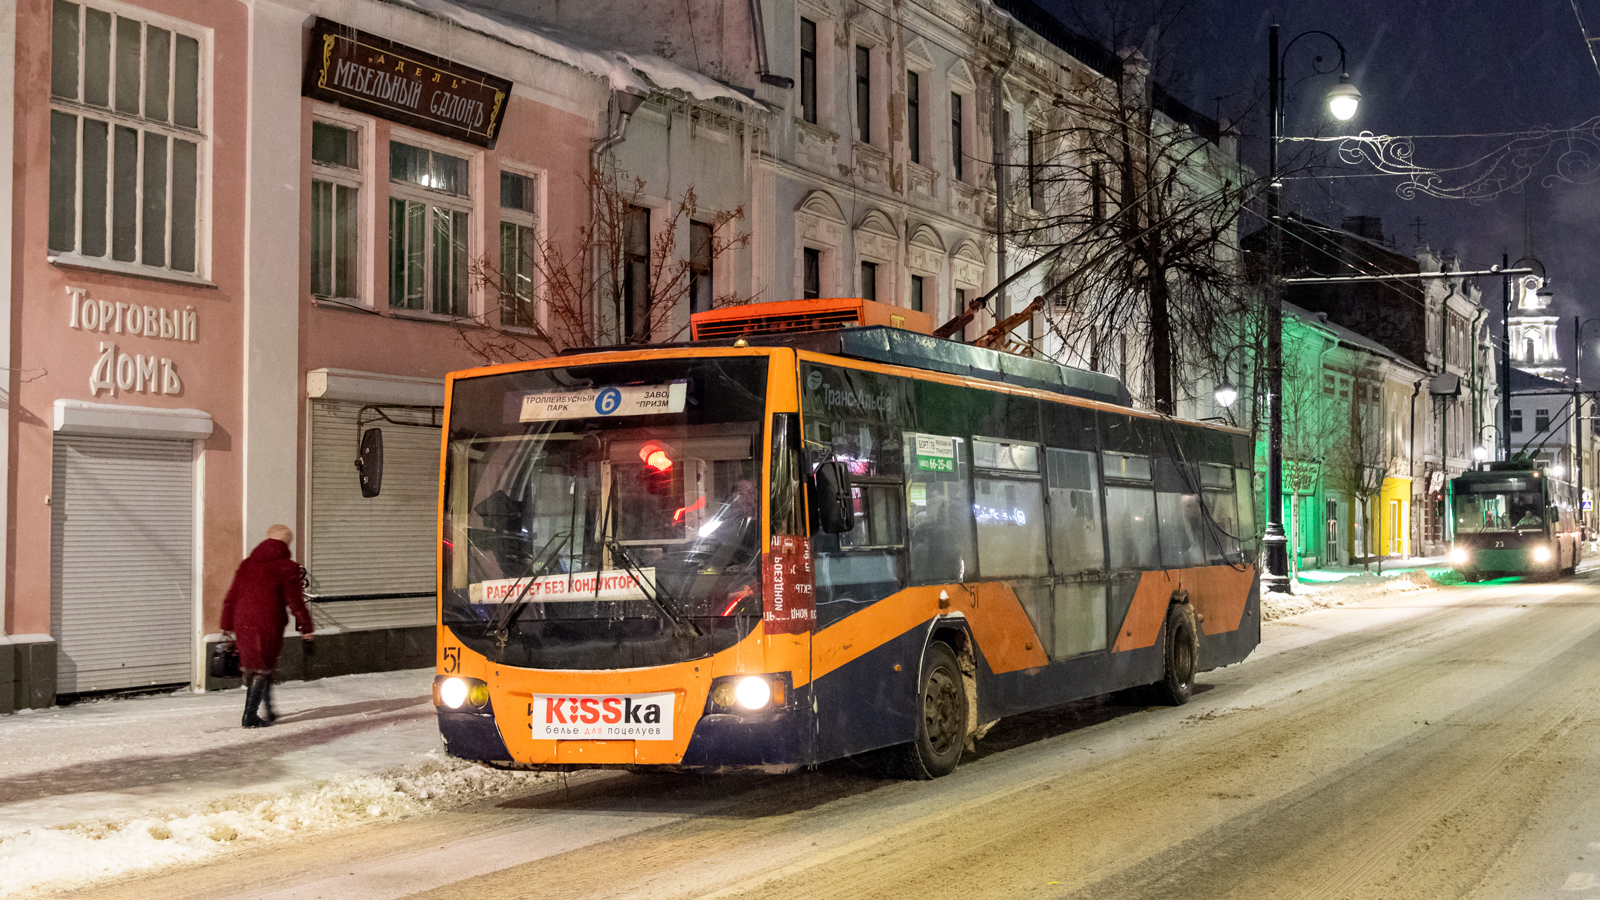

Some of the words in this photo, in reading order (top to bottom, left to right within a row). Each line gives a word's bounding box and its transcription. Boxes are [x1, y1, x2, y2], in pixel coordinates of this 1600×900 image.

[334, 58, 422, 109] МЕБЕЛЬНЫЙ
[430, 90, 484, 127] САЛОНЪ
[526, 395, 595, 404] ТРОЛЛЕЙБУСНЫЙ
[601, 391, 616, 412] 6
[644, 391, 669, 399] ЗАВО
[822, 383, 892, 420] Транс-Альфа
[546, 404, 568, 412] ПАРК
[929, 458, 953, 471] 66-25-40
[545, 580, 565, 594] БЕЗ
[970, 585, 979, 608] 51
[443, 647, 461, 674] 51
[545, 725, 579, 735] белье
[584, 727, 603, 735] для
[608, 727, 661, 736] поцелуев
